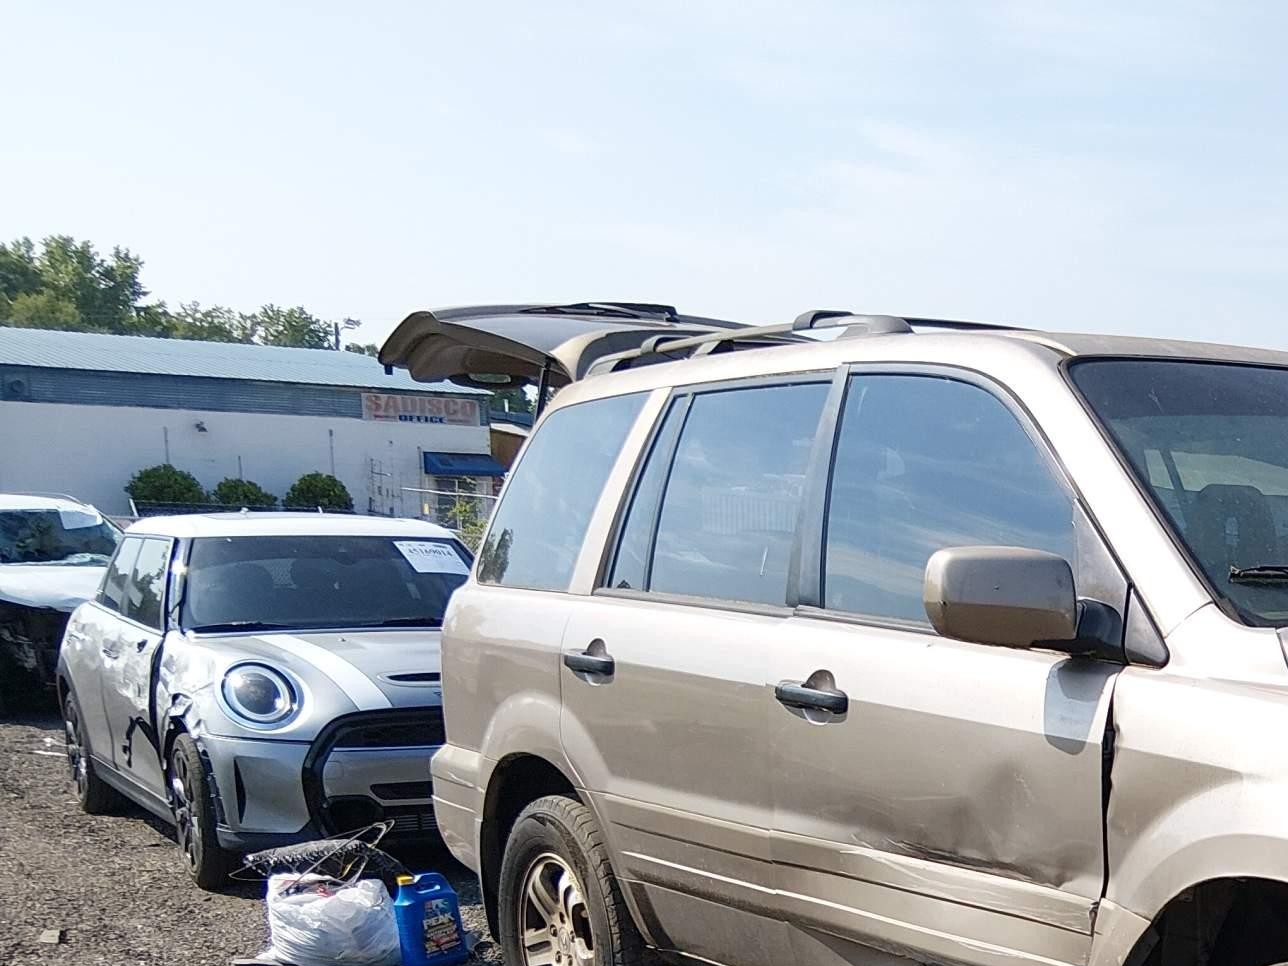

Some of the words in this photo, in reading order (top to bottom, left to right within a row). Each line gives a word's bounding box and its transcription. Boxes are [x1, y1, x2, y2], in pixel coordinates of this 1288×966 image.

[366, 394, 477, 417] SADISCO
[398, 414, 447, 425] OFFICE
[423, 912, 455, 930] PEAK
